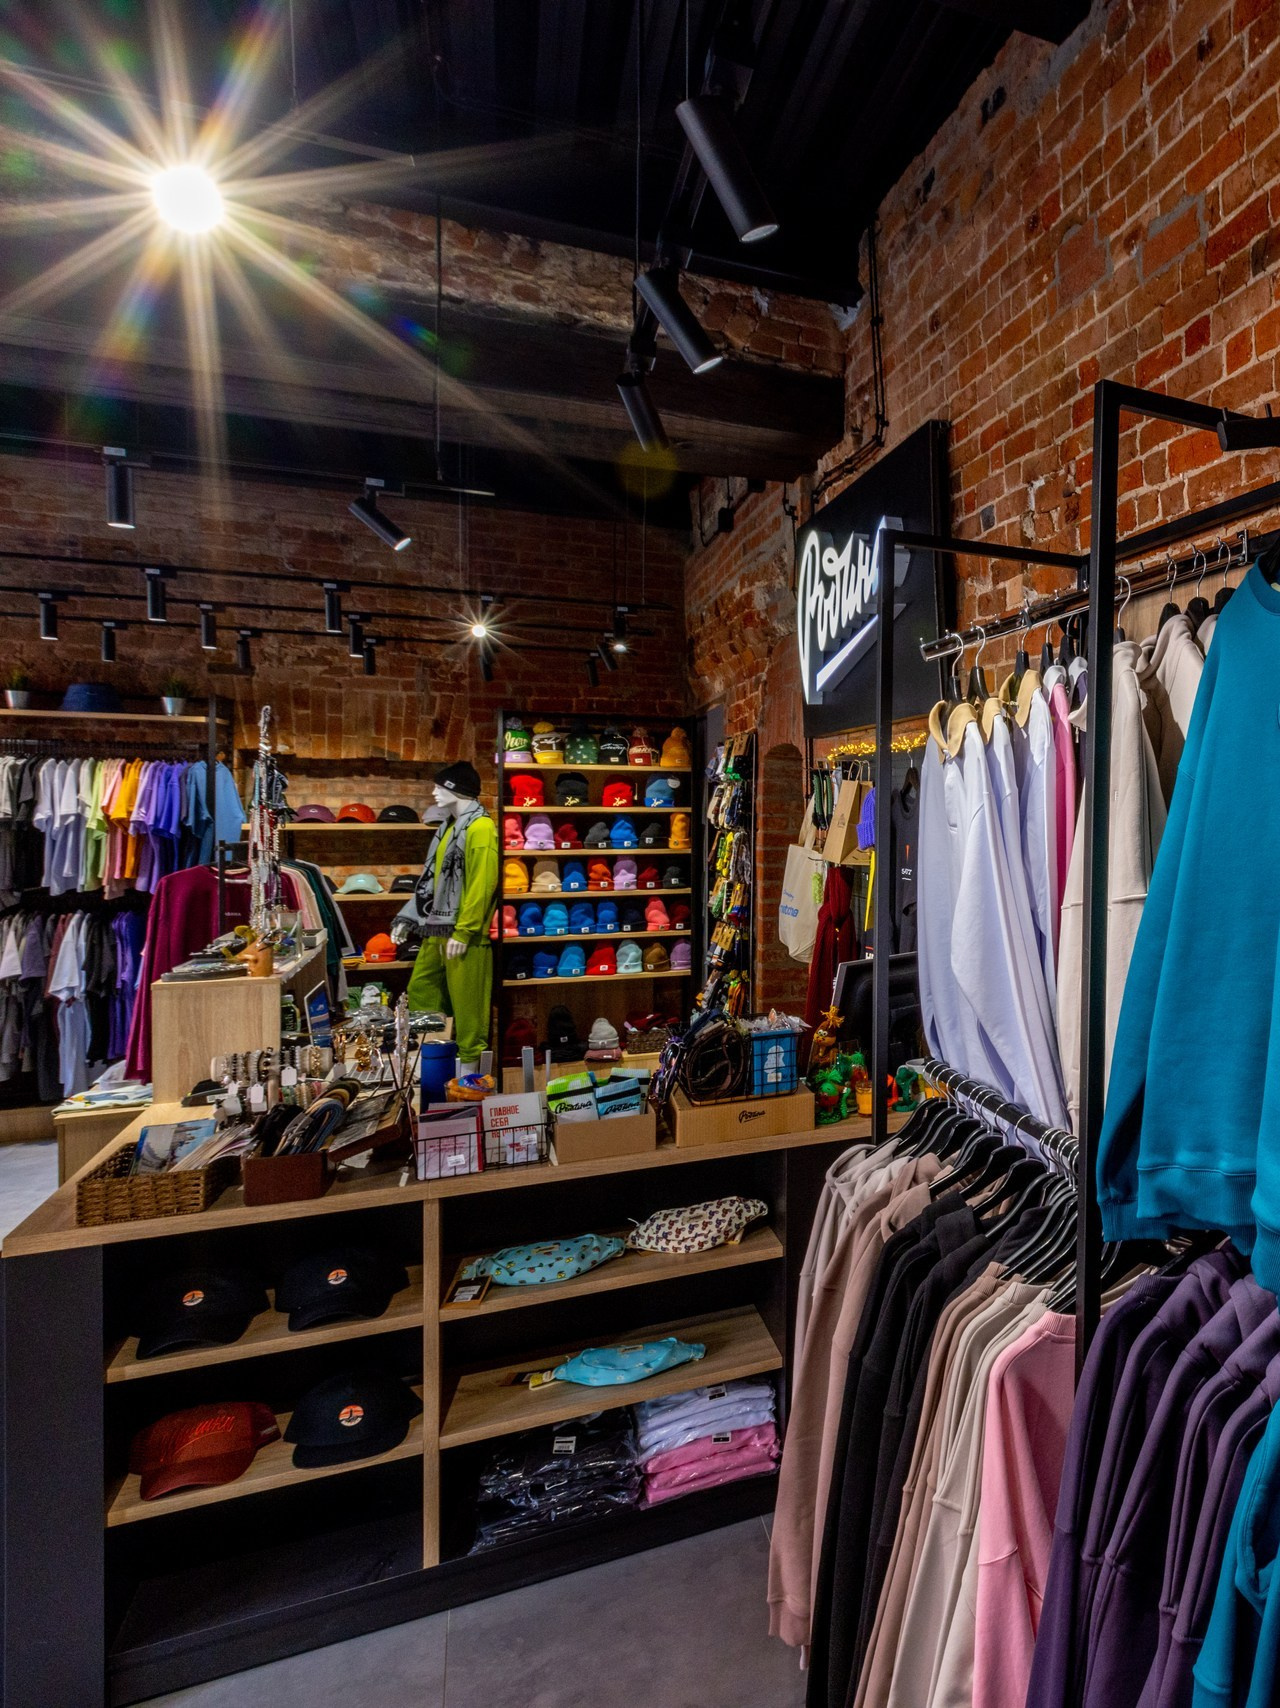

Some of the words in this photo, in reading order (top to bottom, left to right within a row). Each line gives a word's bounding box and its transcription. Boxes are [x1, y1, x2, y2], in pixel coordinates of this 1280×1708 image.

[798, 515, 884, 705] Родин
[489, 1104, 519, 1117] ГЛАВНОЕ
[490, 1116, 509, 1128] СЕБЯ
